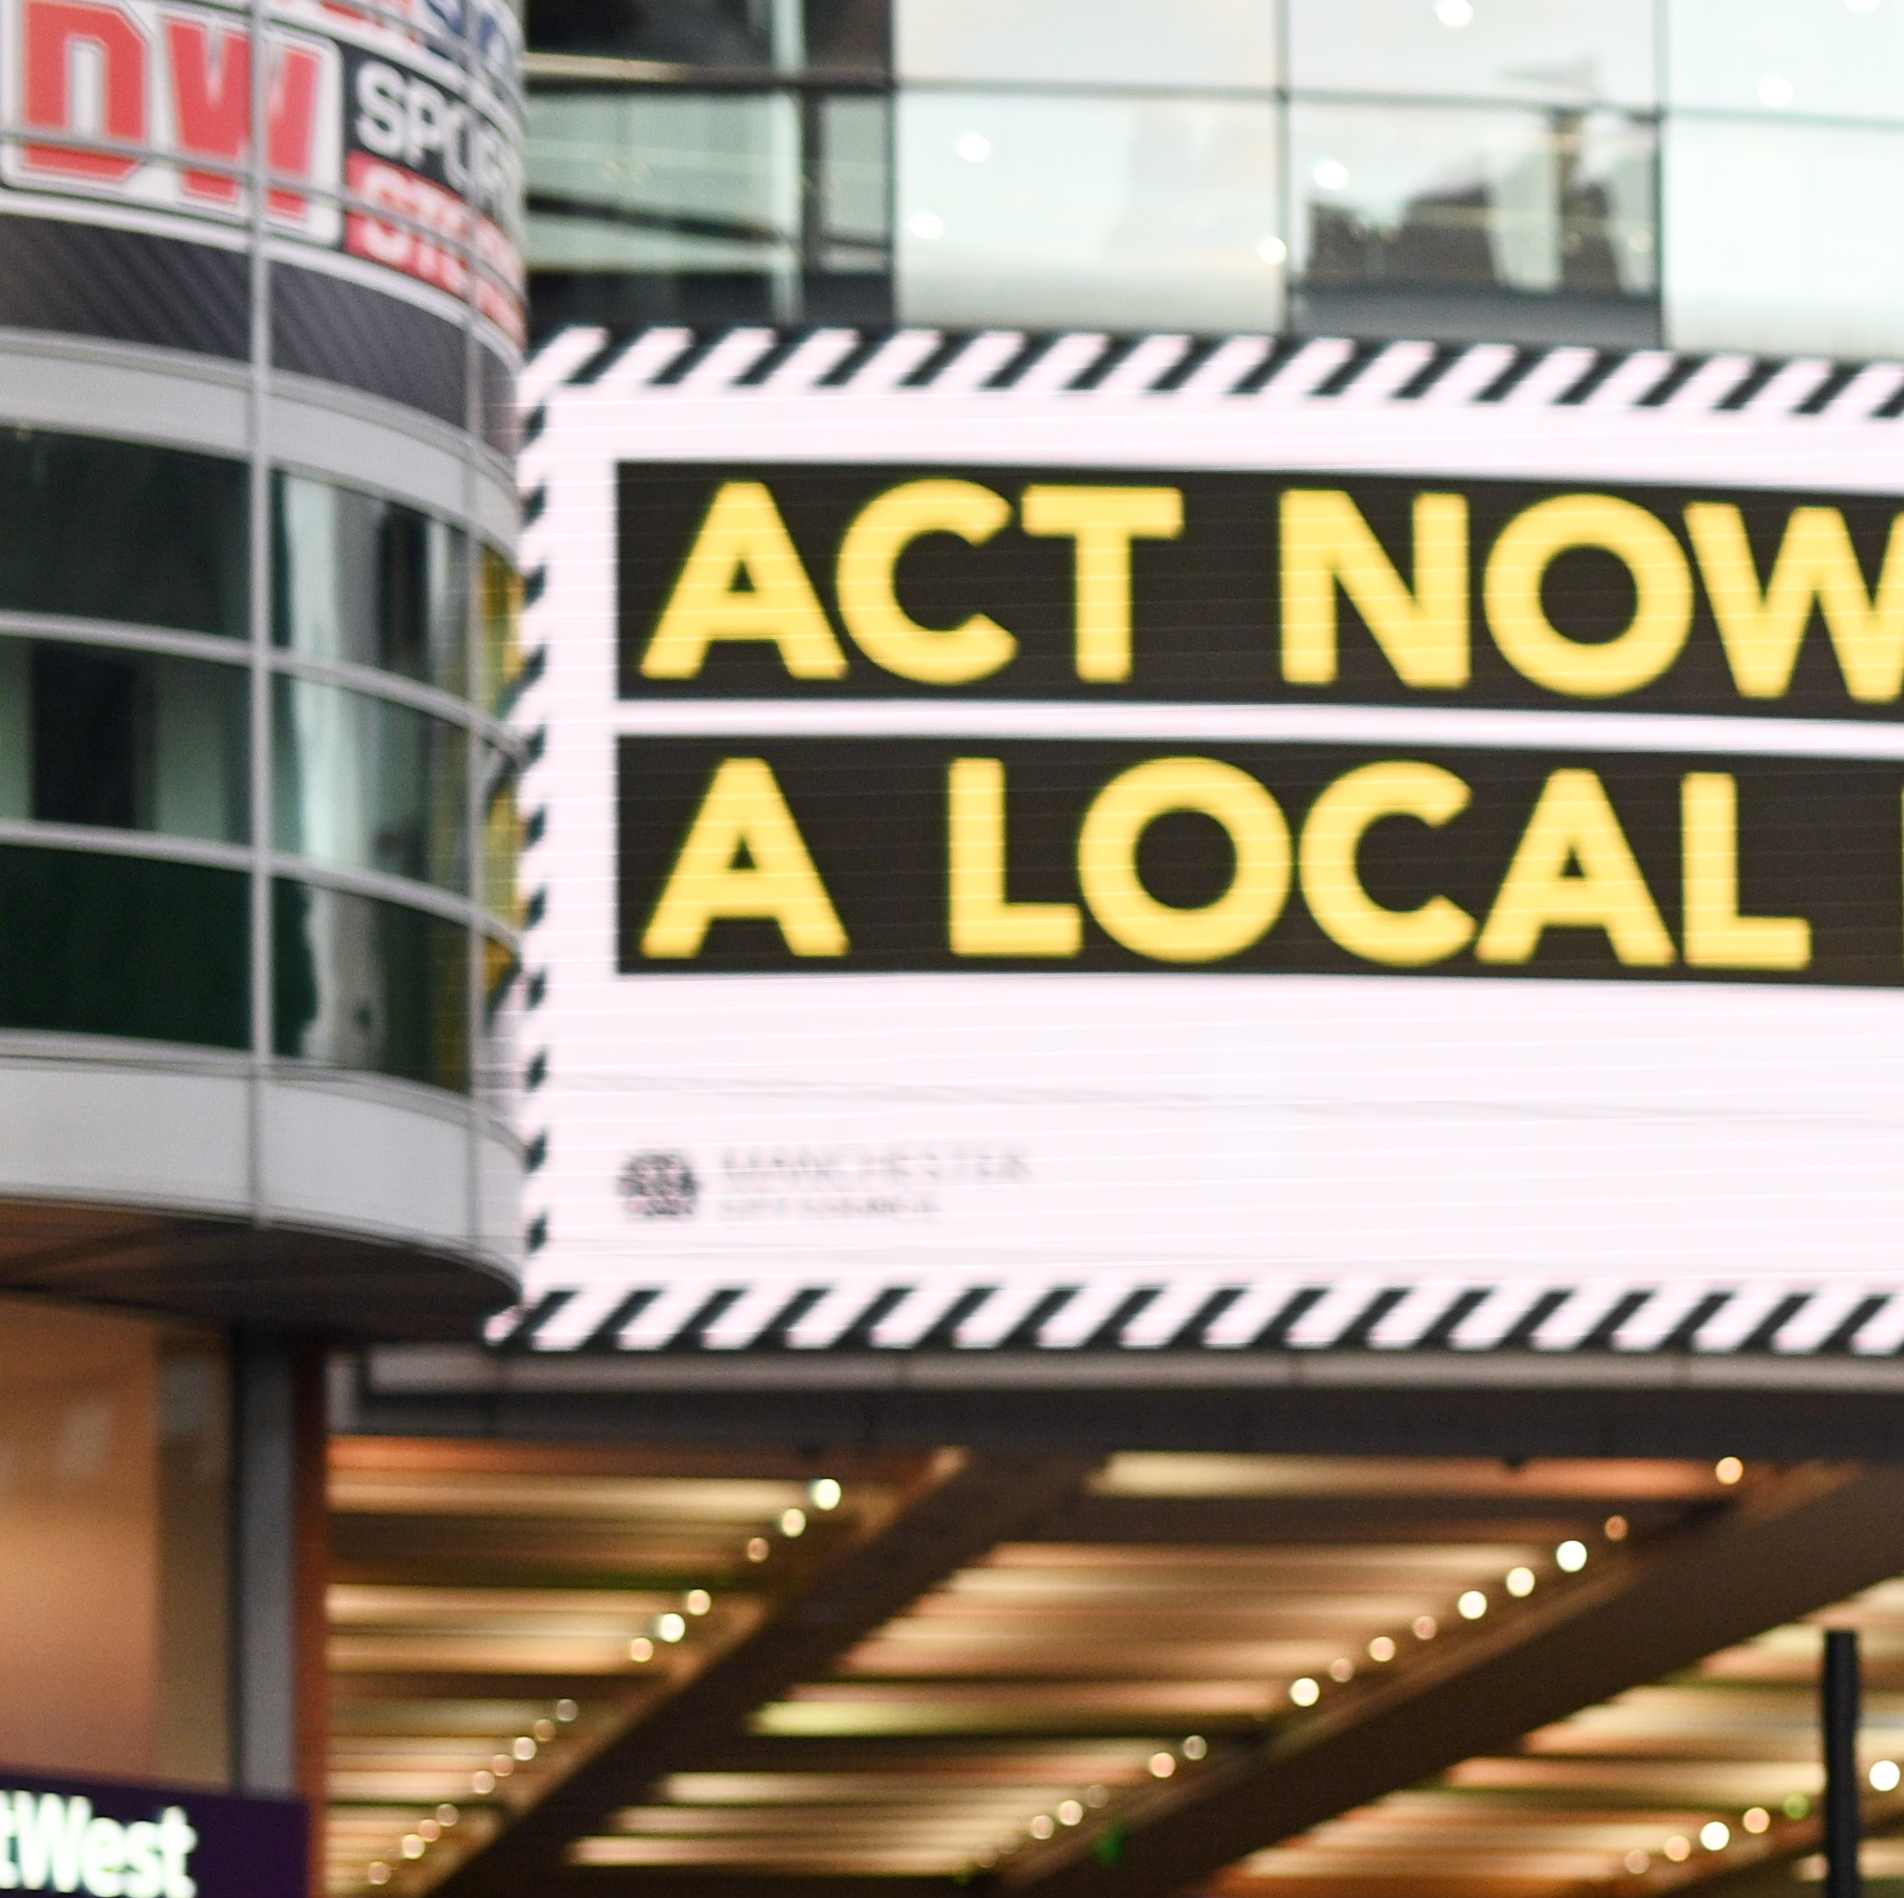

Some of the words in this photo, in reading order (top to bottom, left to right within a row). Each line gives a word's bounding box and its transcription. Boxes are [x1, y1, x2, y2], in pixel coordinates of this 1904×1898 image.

[24, 0, 318, 218] DW
[641, 479, 1184, 684] ACT
[643, 758, 847, 957] A
[948, 757, 1811, 969] LOCAL
